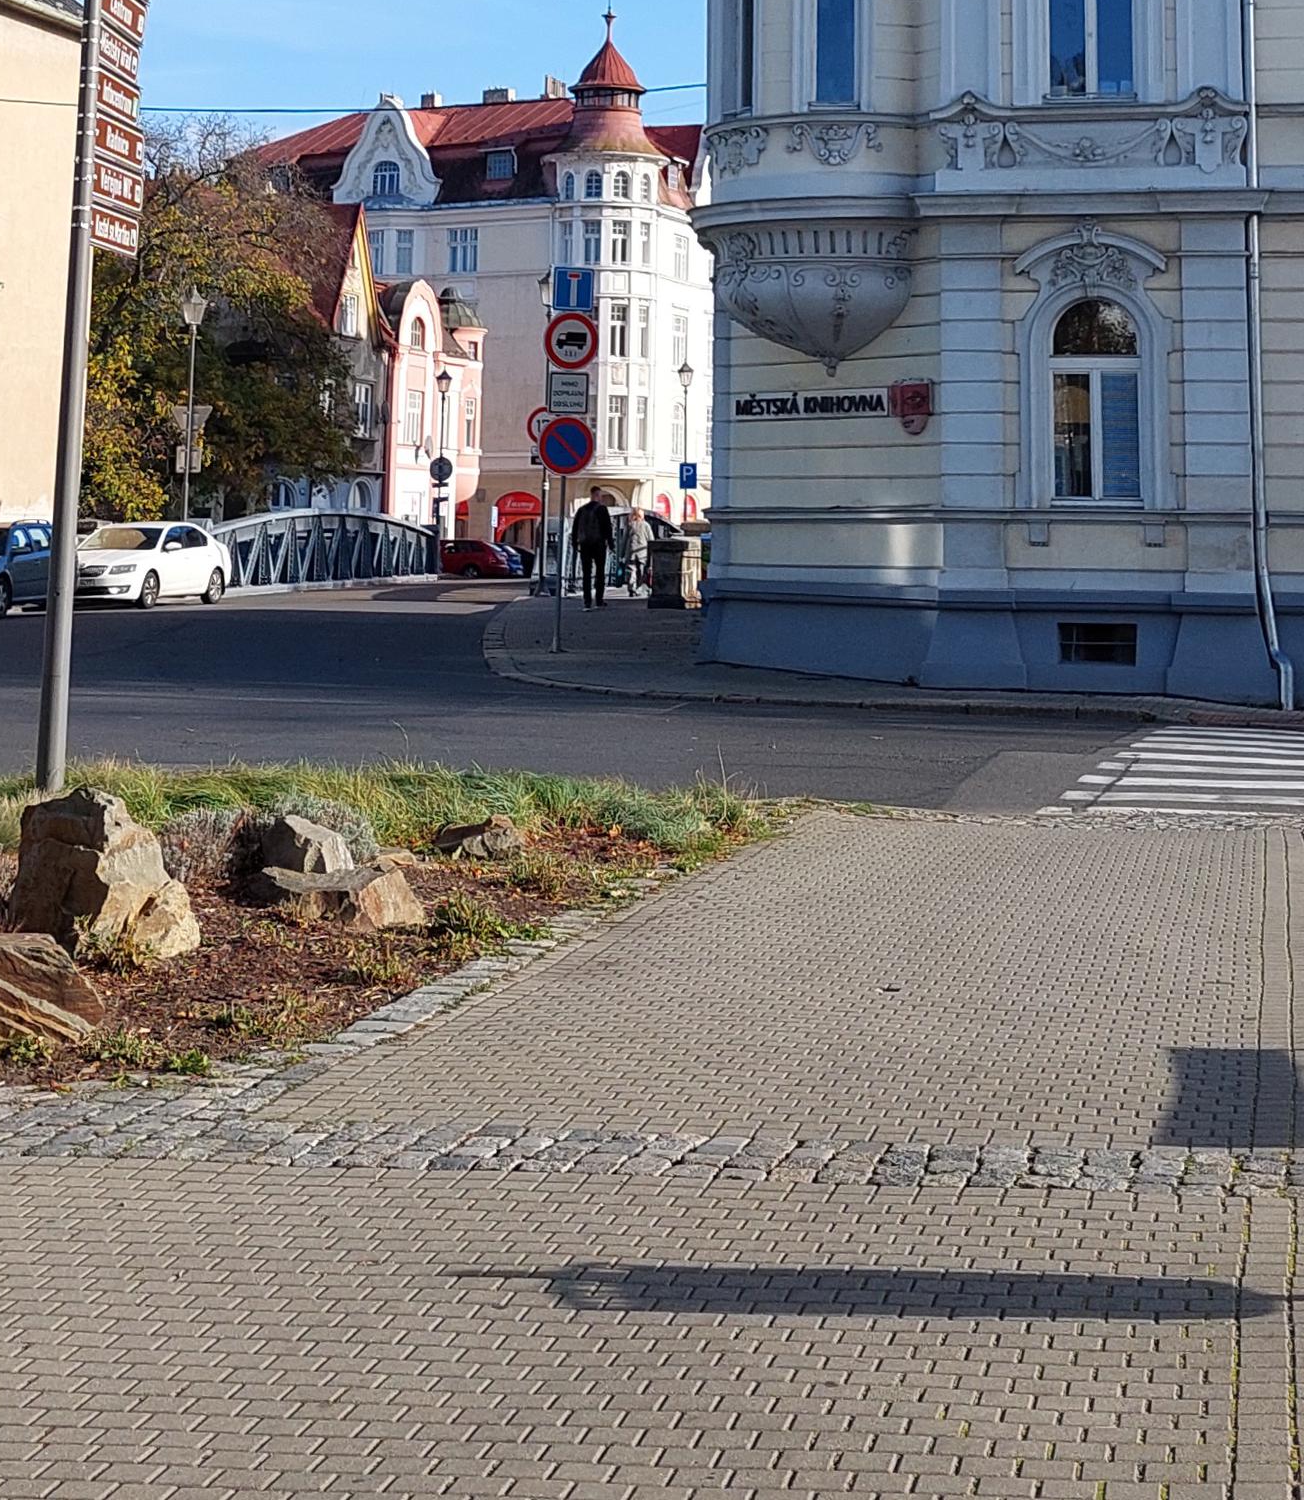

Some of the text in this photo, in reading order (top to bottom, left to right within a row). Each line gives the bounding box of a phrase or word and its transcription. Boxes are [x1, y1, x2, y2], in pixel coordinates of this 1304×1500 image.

[106, 124, 129, 156] Radnice
[100, 166, 122, 199] Veřejné
[735, 392, 886, 416] MĚSTSKÁ KNIHOVNA
[682, 465, 694, 482] P
